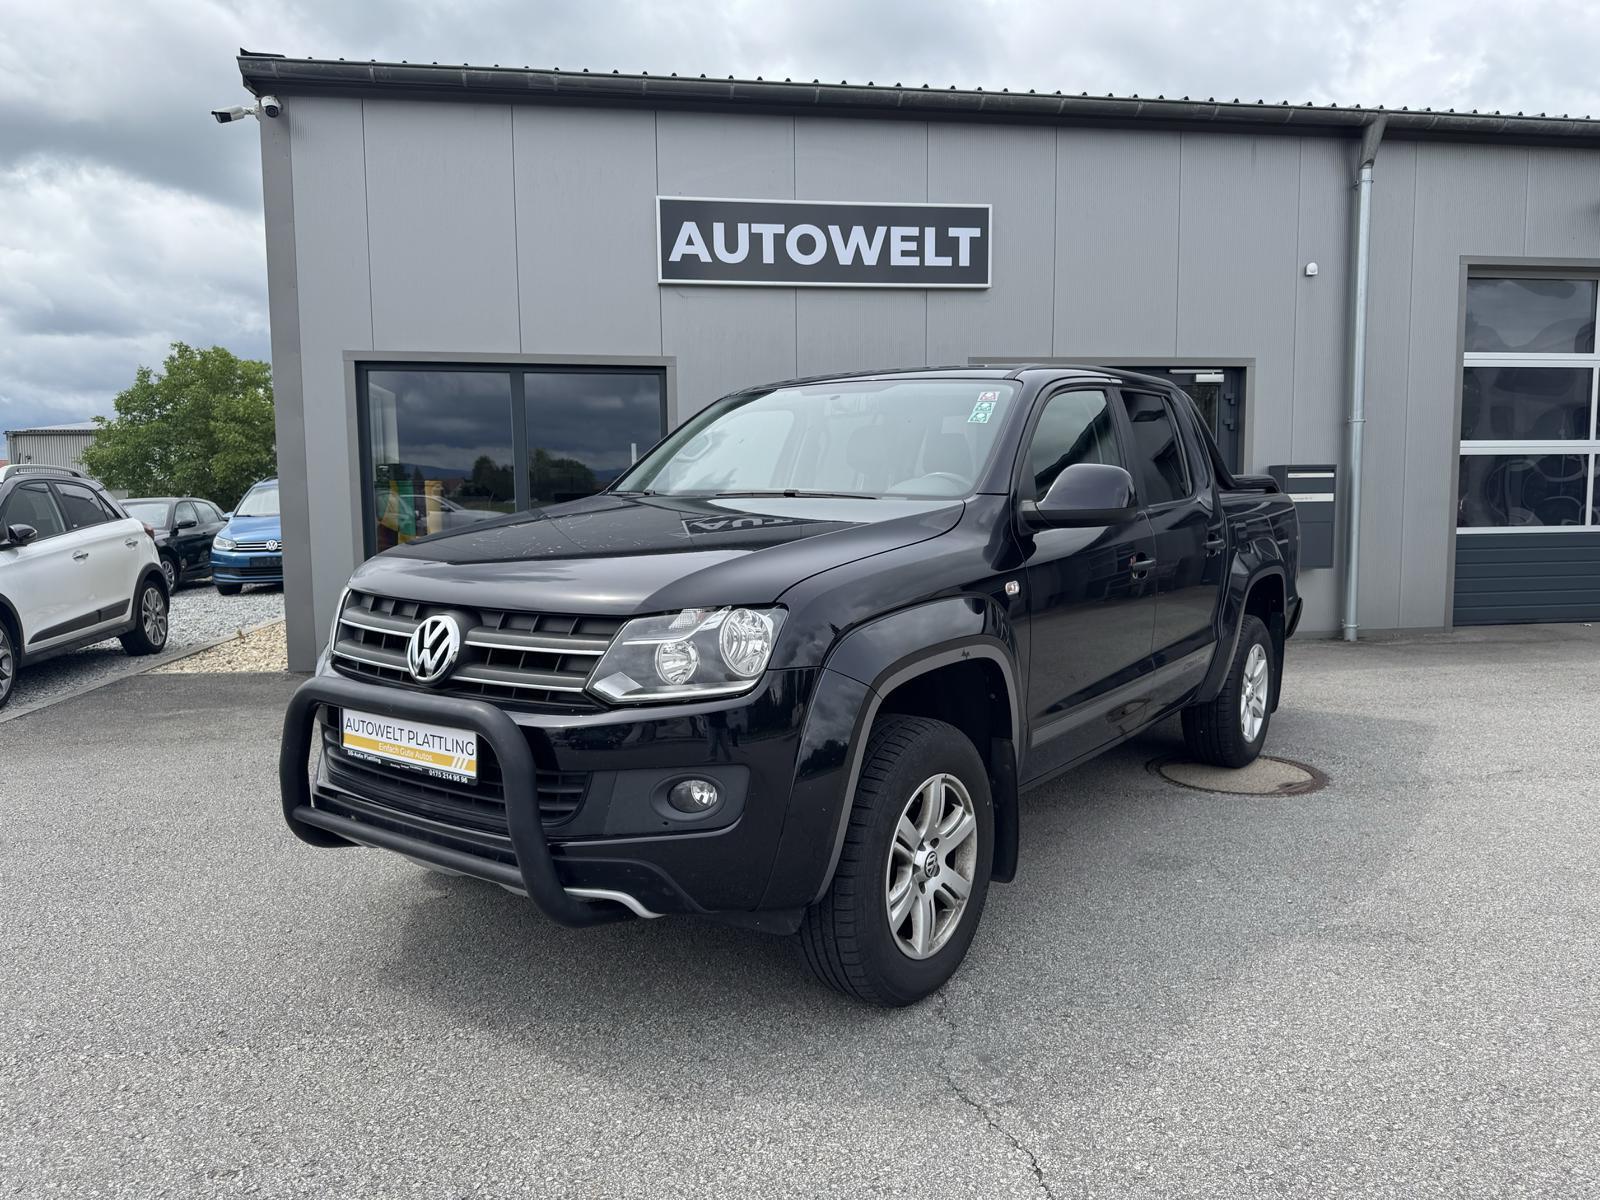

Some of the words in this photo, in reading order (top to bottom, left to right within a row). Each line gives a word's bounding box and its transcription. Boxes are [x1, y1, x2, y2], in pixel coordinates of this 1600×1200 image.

[668, 221, 981, 267] AUTOWELT
[345, 718, 404, 742] AUTOWELT
[407, 730, 475, 756] PLATTLING
